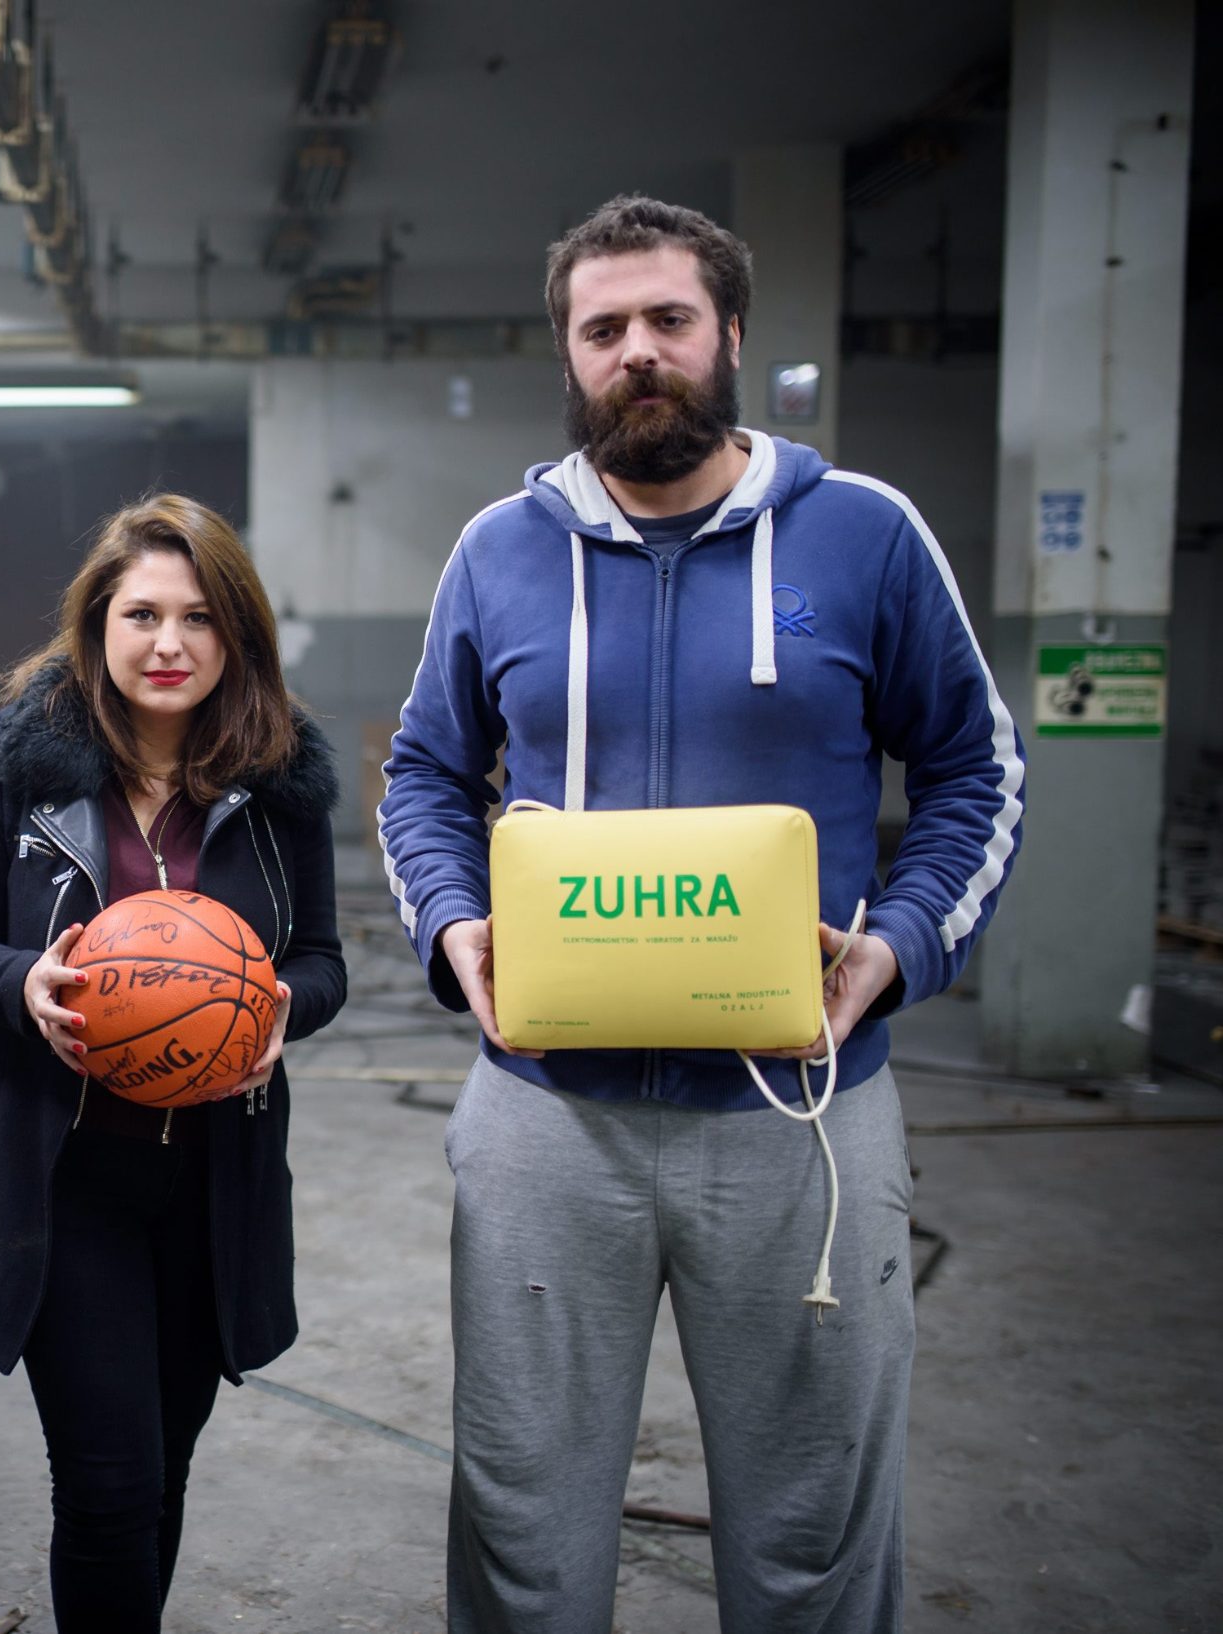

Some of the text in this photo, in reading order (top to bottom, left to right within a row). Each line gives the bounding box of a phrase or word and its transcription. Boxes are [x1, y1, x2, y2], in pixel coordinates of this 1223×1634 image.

[559, 873, 741, 920] ZUHRA
[691, 988, 791, 1000] METALNA INDUSTRIJA
